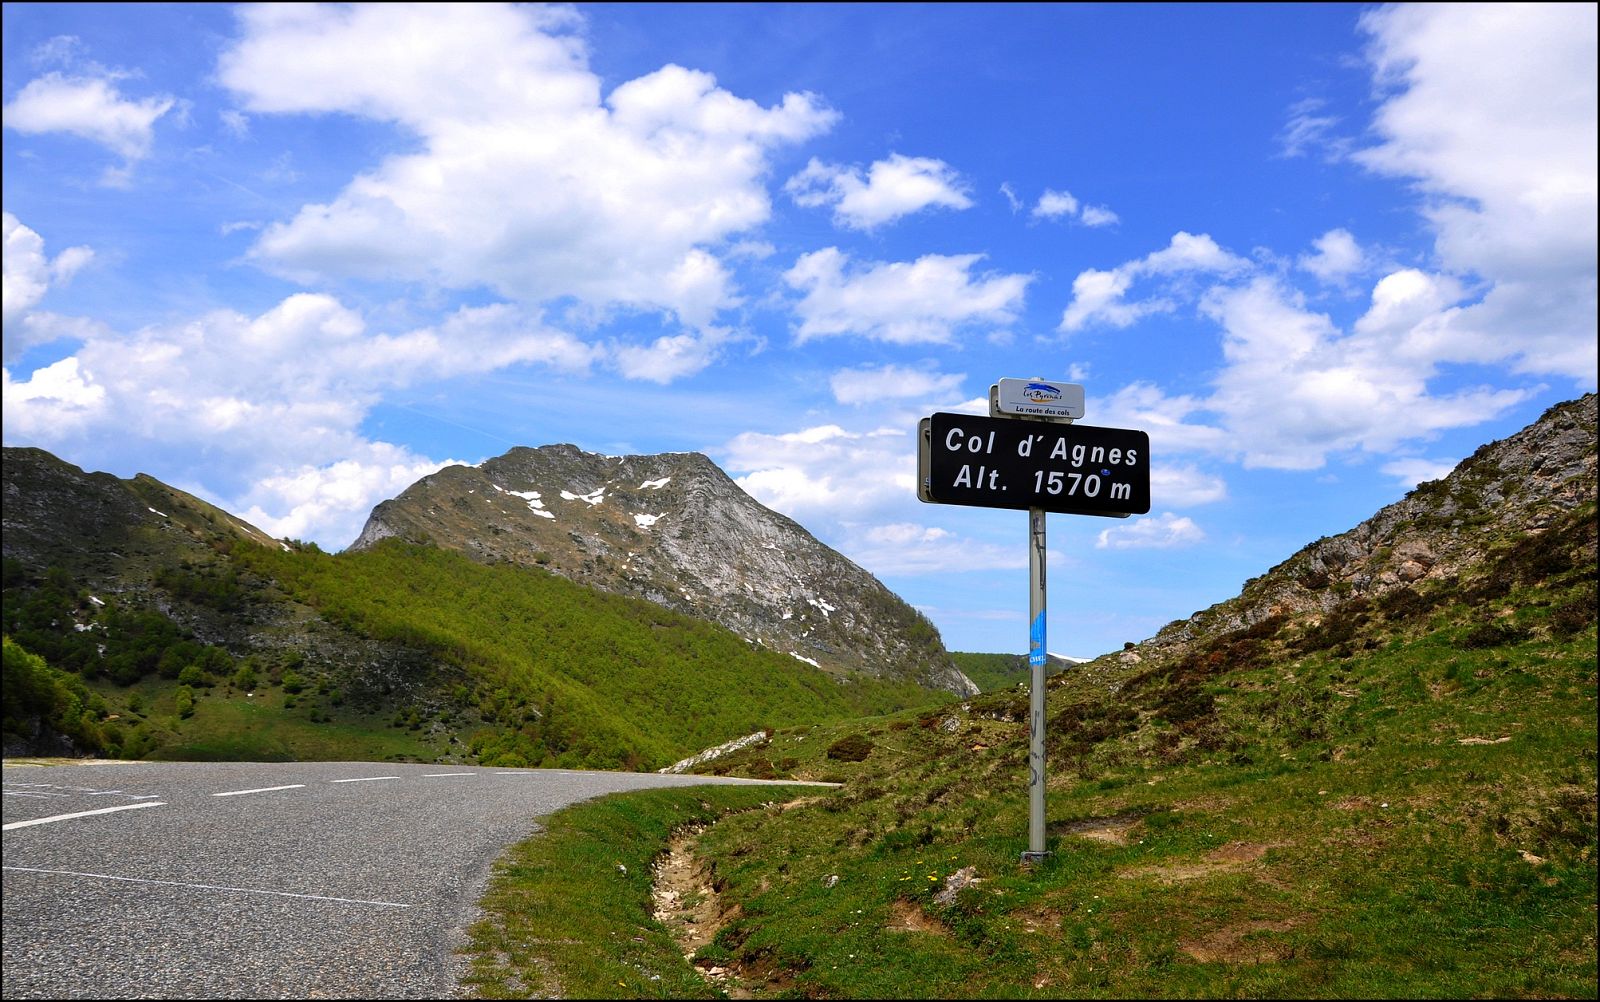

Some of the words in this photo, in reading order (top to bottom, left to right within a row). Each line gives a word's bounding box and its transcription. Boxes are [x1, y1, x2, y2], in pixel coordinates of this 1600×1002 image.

[945, 428, 995, 454] Col
[953, 465, 1007, 491] Alt.
[1034, 470, 1101, 498] 1570
[1110, 482, 1131, 500] m
